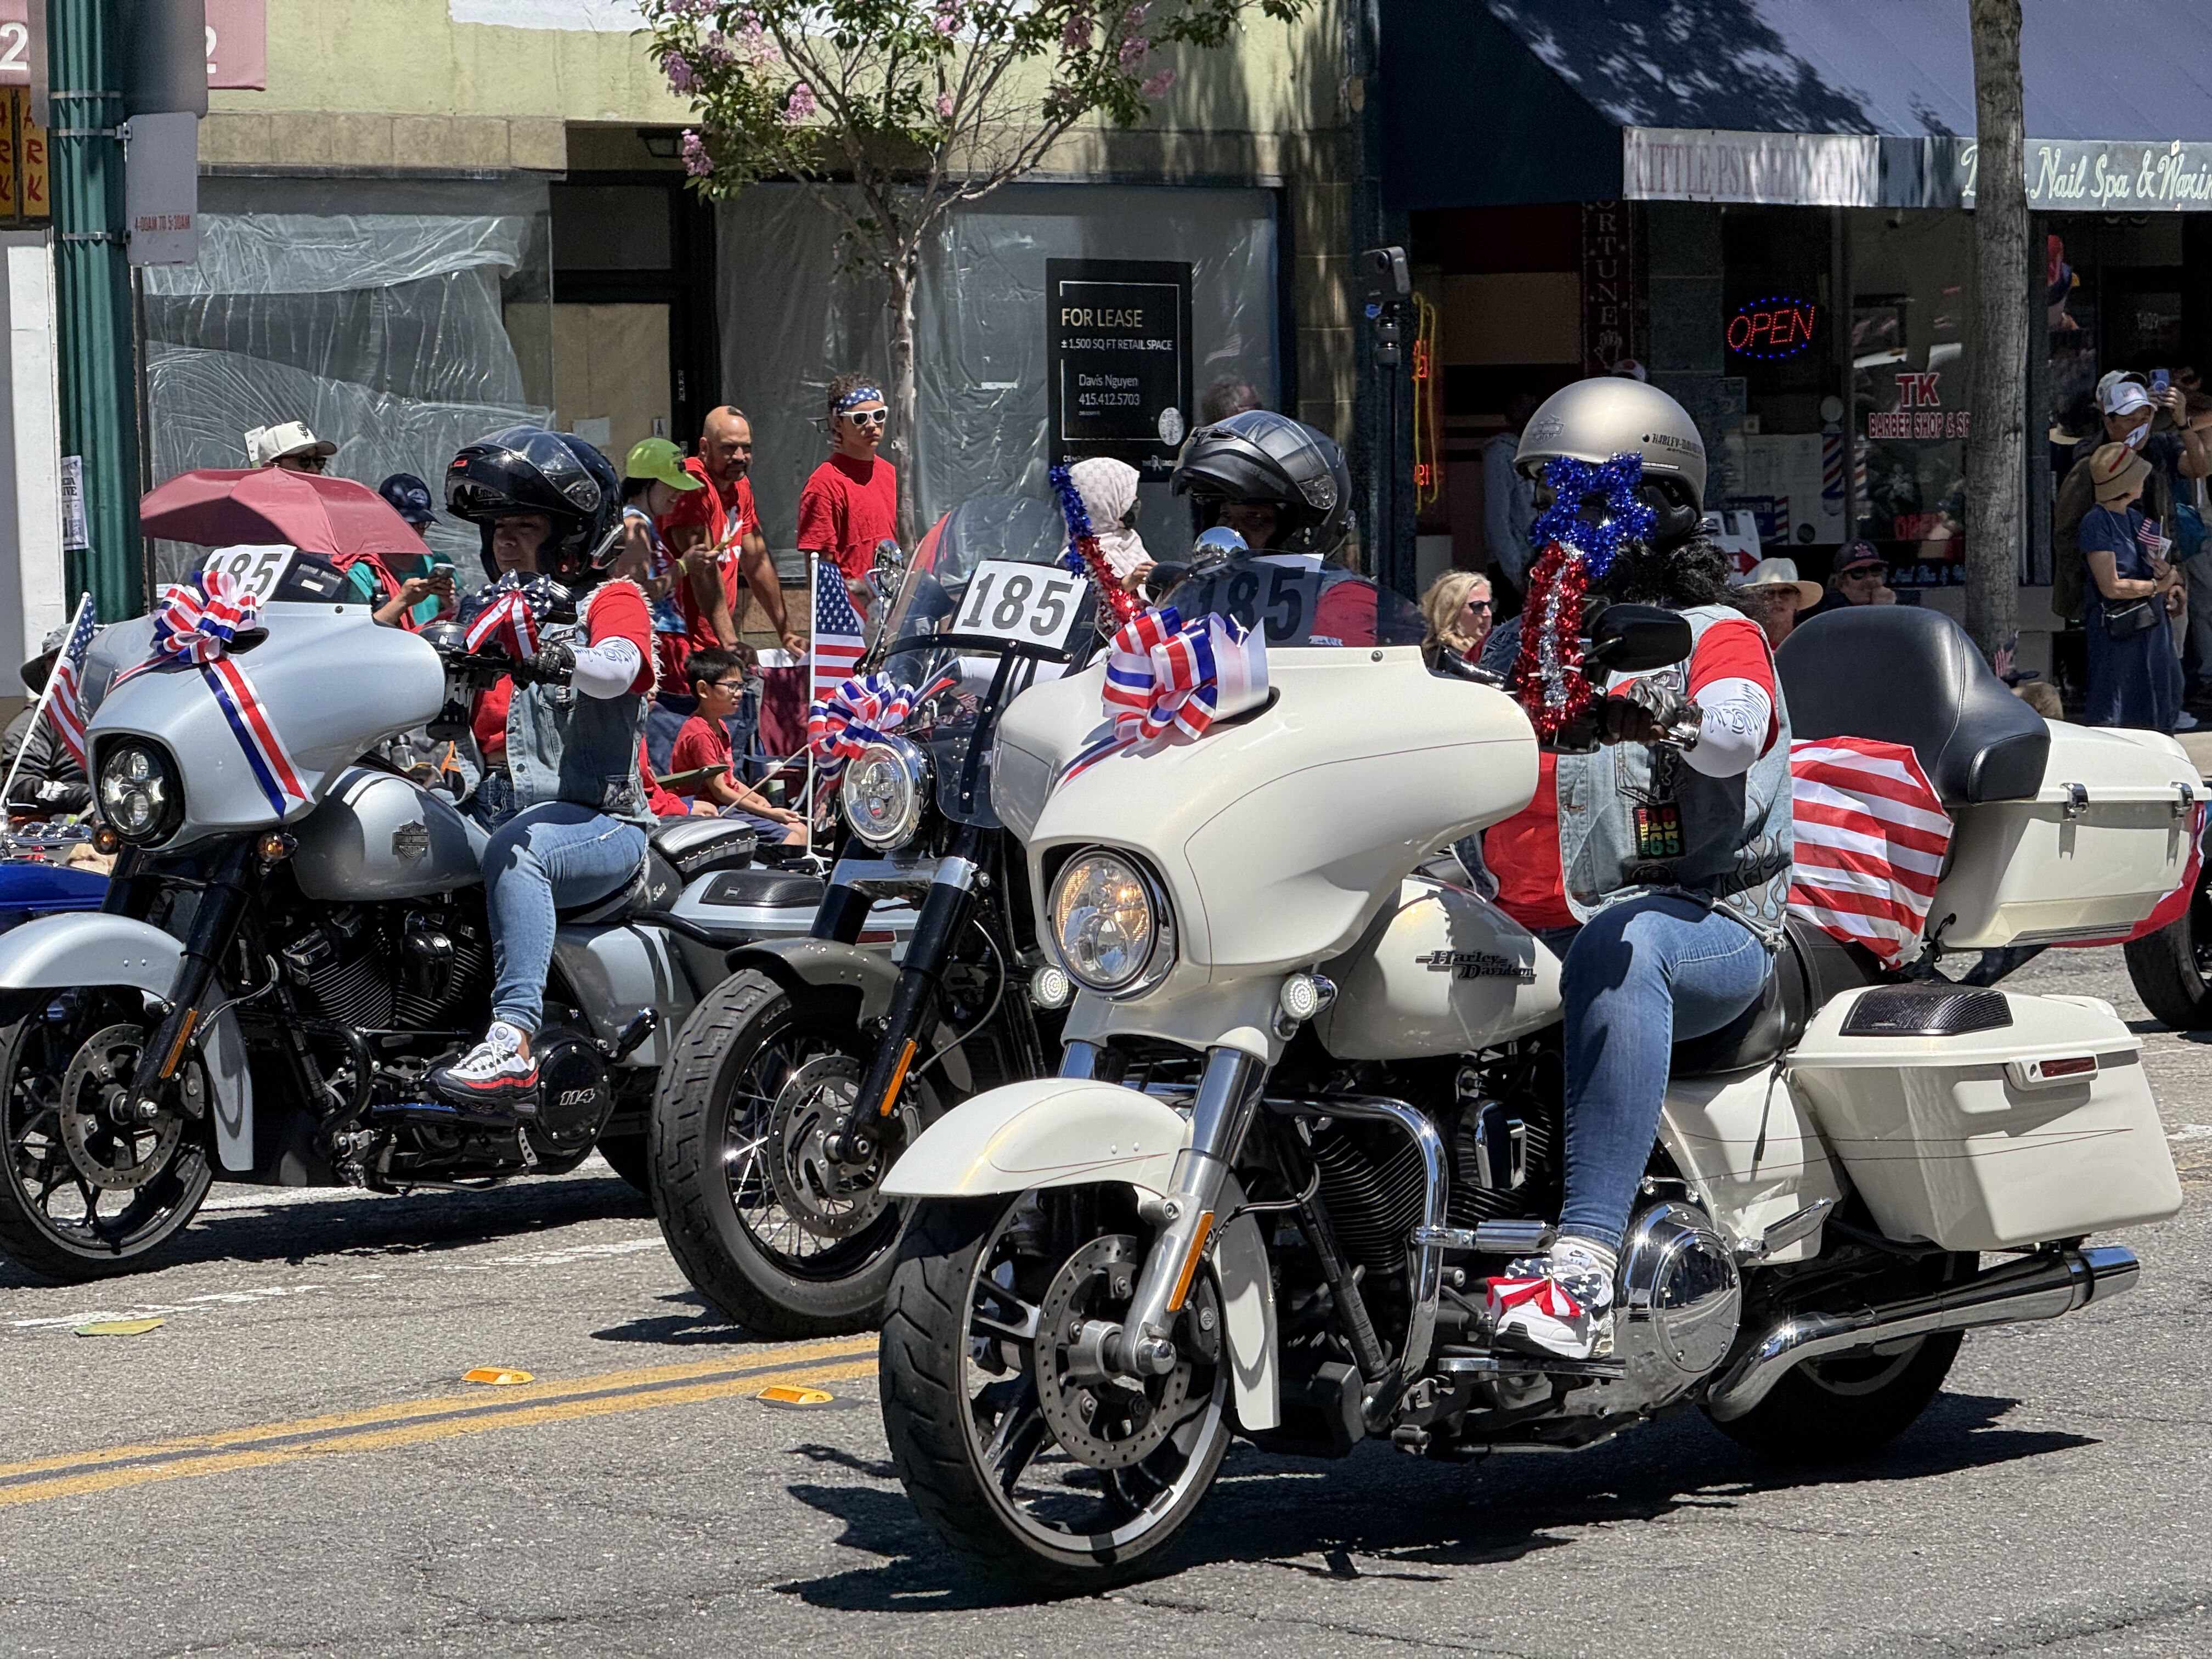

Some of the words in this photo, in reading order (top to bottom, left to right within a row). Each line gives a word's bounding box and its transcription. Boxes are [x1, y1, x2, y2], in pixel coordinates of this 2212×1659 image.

[2030, 146, 2087, 200] Nail
[2091, 154, 2129, 207] Spa
[2136, 150, 2155, 198] &
[1062, 308, 1093, 326] FOR
[1097, 308, 1143, 328] LEASE
[1728, 306, 1815, 348] OPEN
[1092, 339, 1105, 351] SQ
[1106, 339, 1116, 349] FT
[1118, 339, 1145, 350] RETAIL
[1146, 340, 1173, 351] SPACE
[1079, 374, 1103, 387] Davis
[1105, 375, 1138, 389] Nguyen
[1895, 373, 1940, 407] TK
[1079, 393, 1140, 406] 415.412.5703
[1869, 413, 1912, 438] BARBER
[1914, 413, 1943, 438] SHOP
[1652, 433, 1704, 456] HARLEY-D
[961, 573, 1074, 636] 185
[1650, 831, 1680, 855] 65
[1458, 963, 1534, 979] Davidson
[560, 1088, 595, 1105] 114
